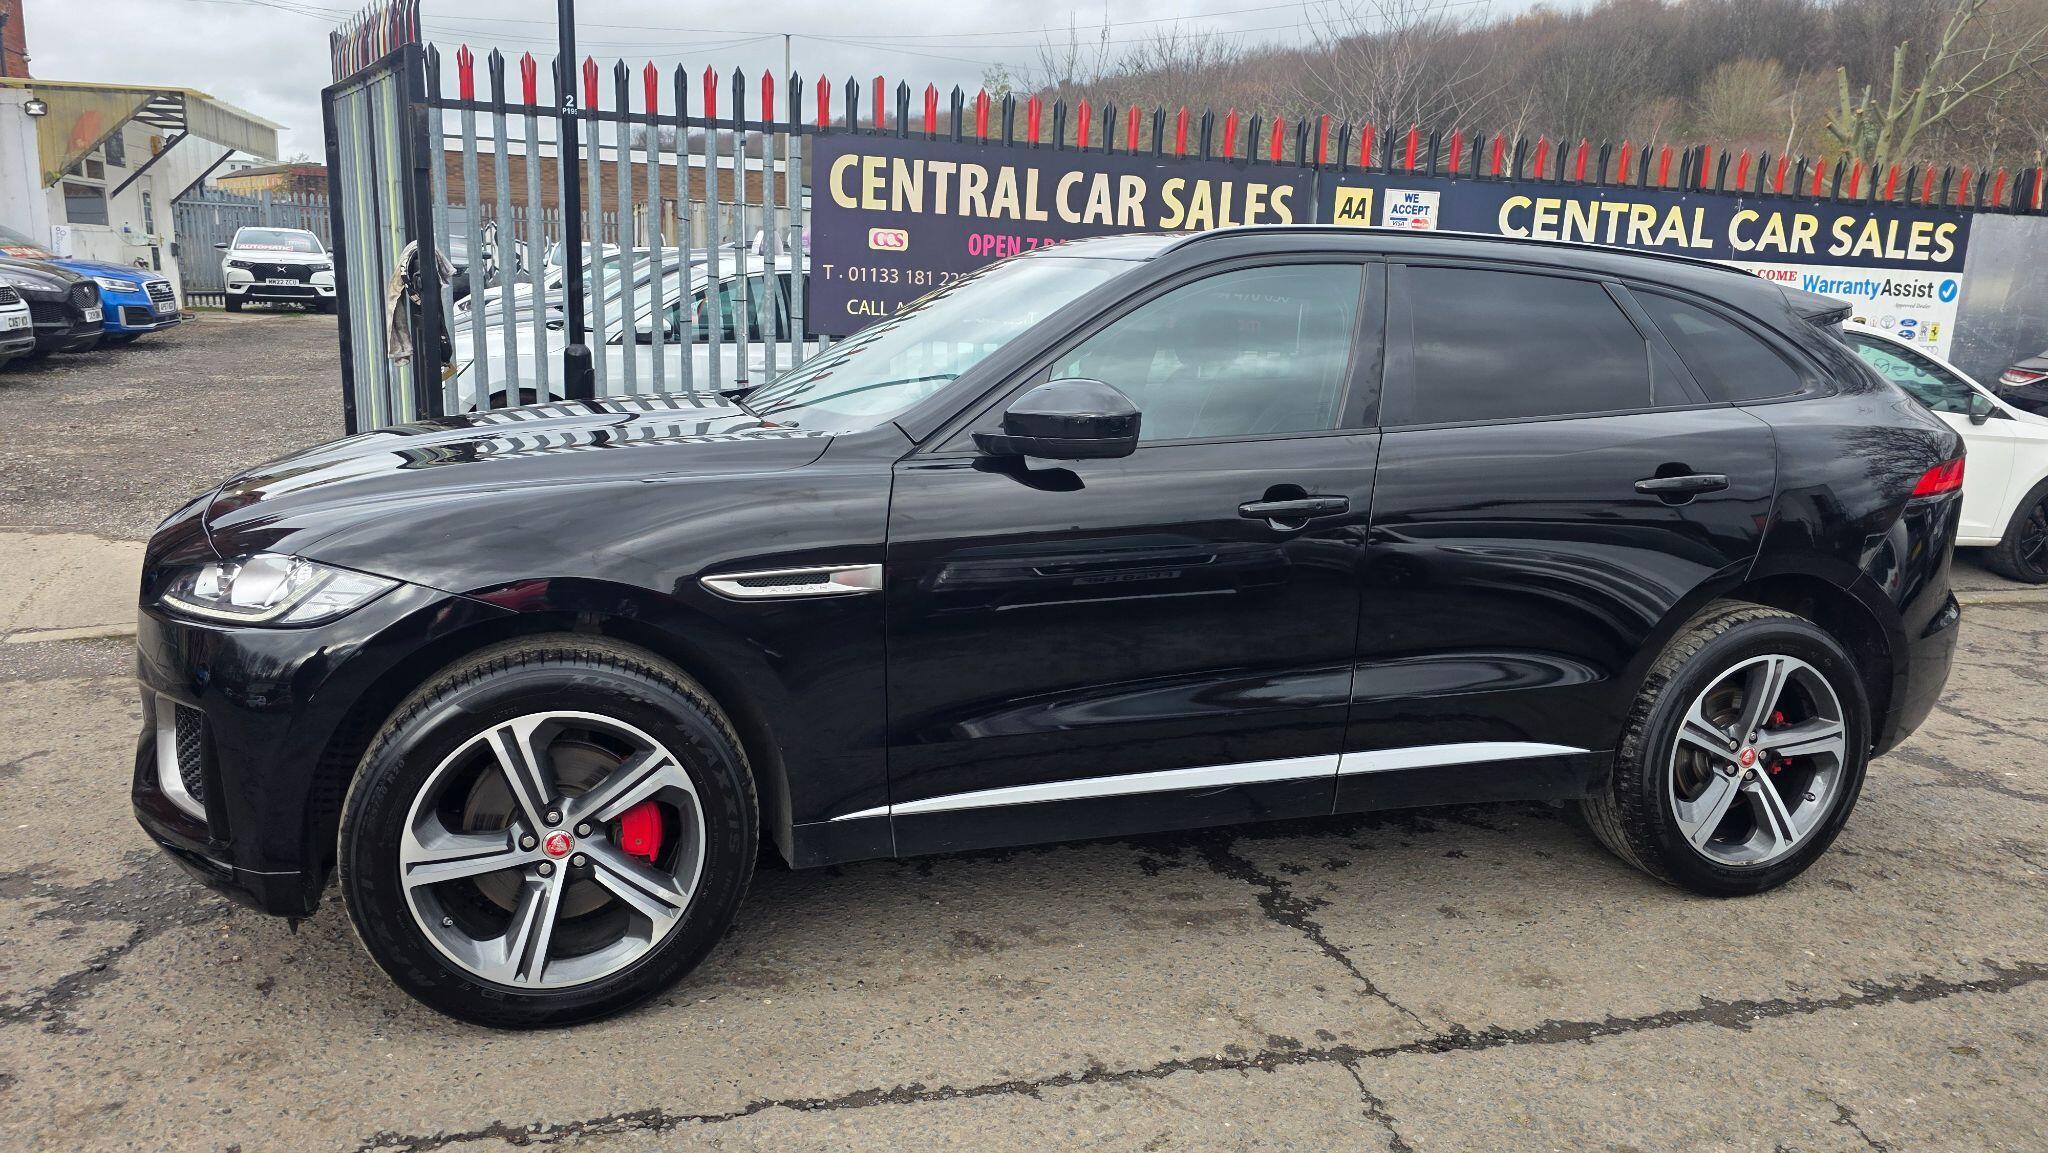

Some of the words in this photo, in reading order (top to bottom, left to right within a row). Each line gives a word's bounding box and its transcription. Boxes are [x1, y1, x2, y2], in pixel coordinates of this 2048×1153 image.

[565, 94, 575, 107] 2
[829, 154, 1049, 221] CENTRAL
[1055, 171, 1146, 227] CAR
[1159, 177, 1294, 231] SALES
[1404, 192, 1420, 204] WE
[1337, 196, 1367, 219] AA
[1391, 204, 1430, 216] ACCEPT
[1498, 195, 1714, 249] CENTRAL
[1728, 209, 1819, 254] CAR
[1828, 215, 1958, 263] SALES
[968, 233, 1021, 258] OPEN
[848, 266, 899, 284] 01133
[906, 269, 932, 286] 181
[846, 299, 889, 316] CALL
